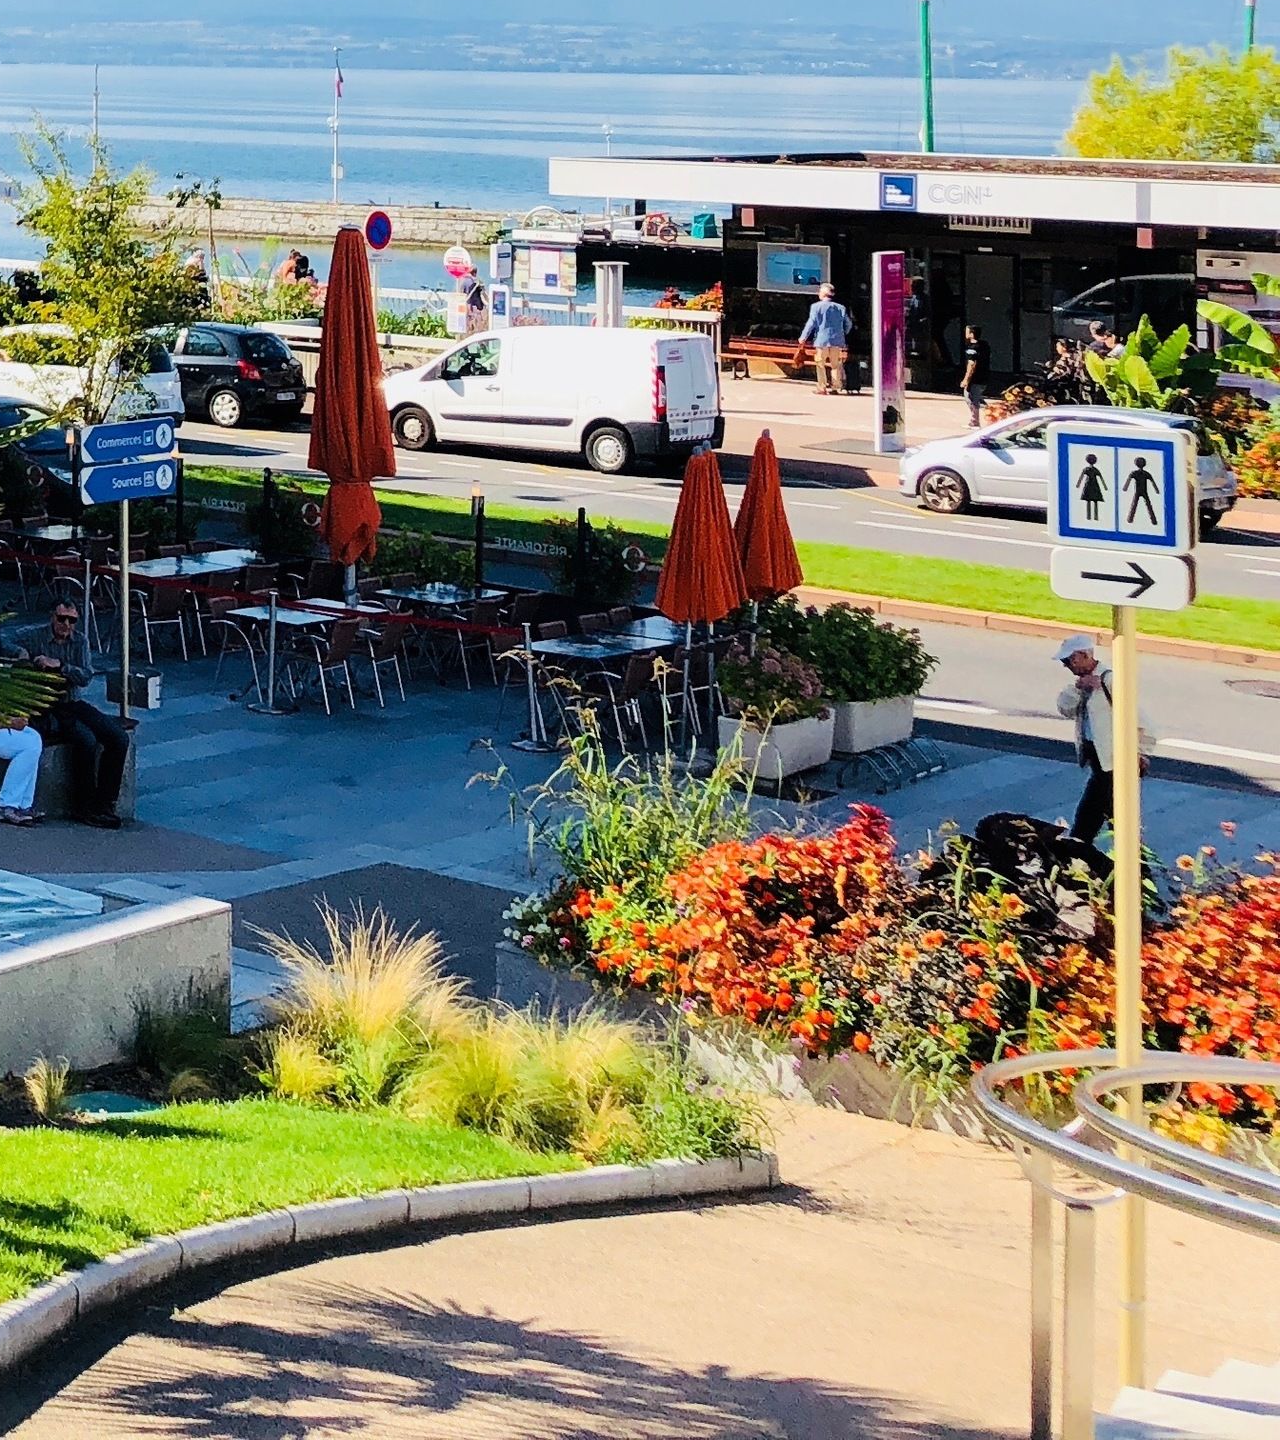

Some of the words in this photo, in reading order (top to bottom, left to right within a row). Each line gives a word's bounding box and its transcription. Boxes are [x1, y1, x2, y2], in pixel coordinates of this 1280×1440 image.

[928, 183, 982, 205] CGN
[96, 437, 142, 449] Commerces
[112, 476, 142, 489] Sources
